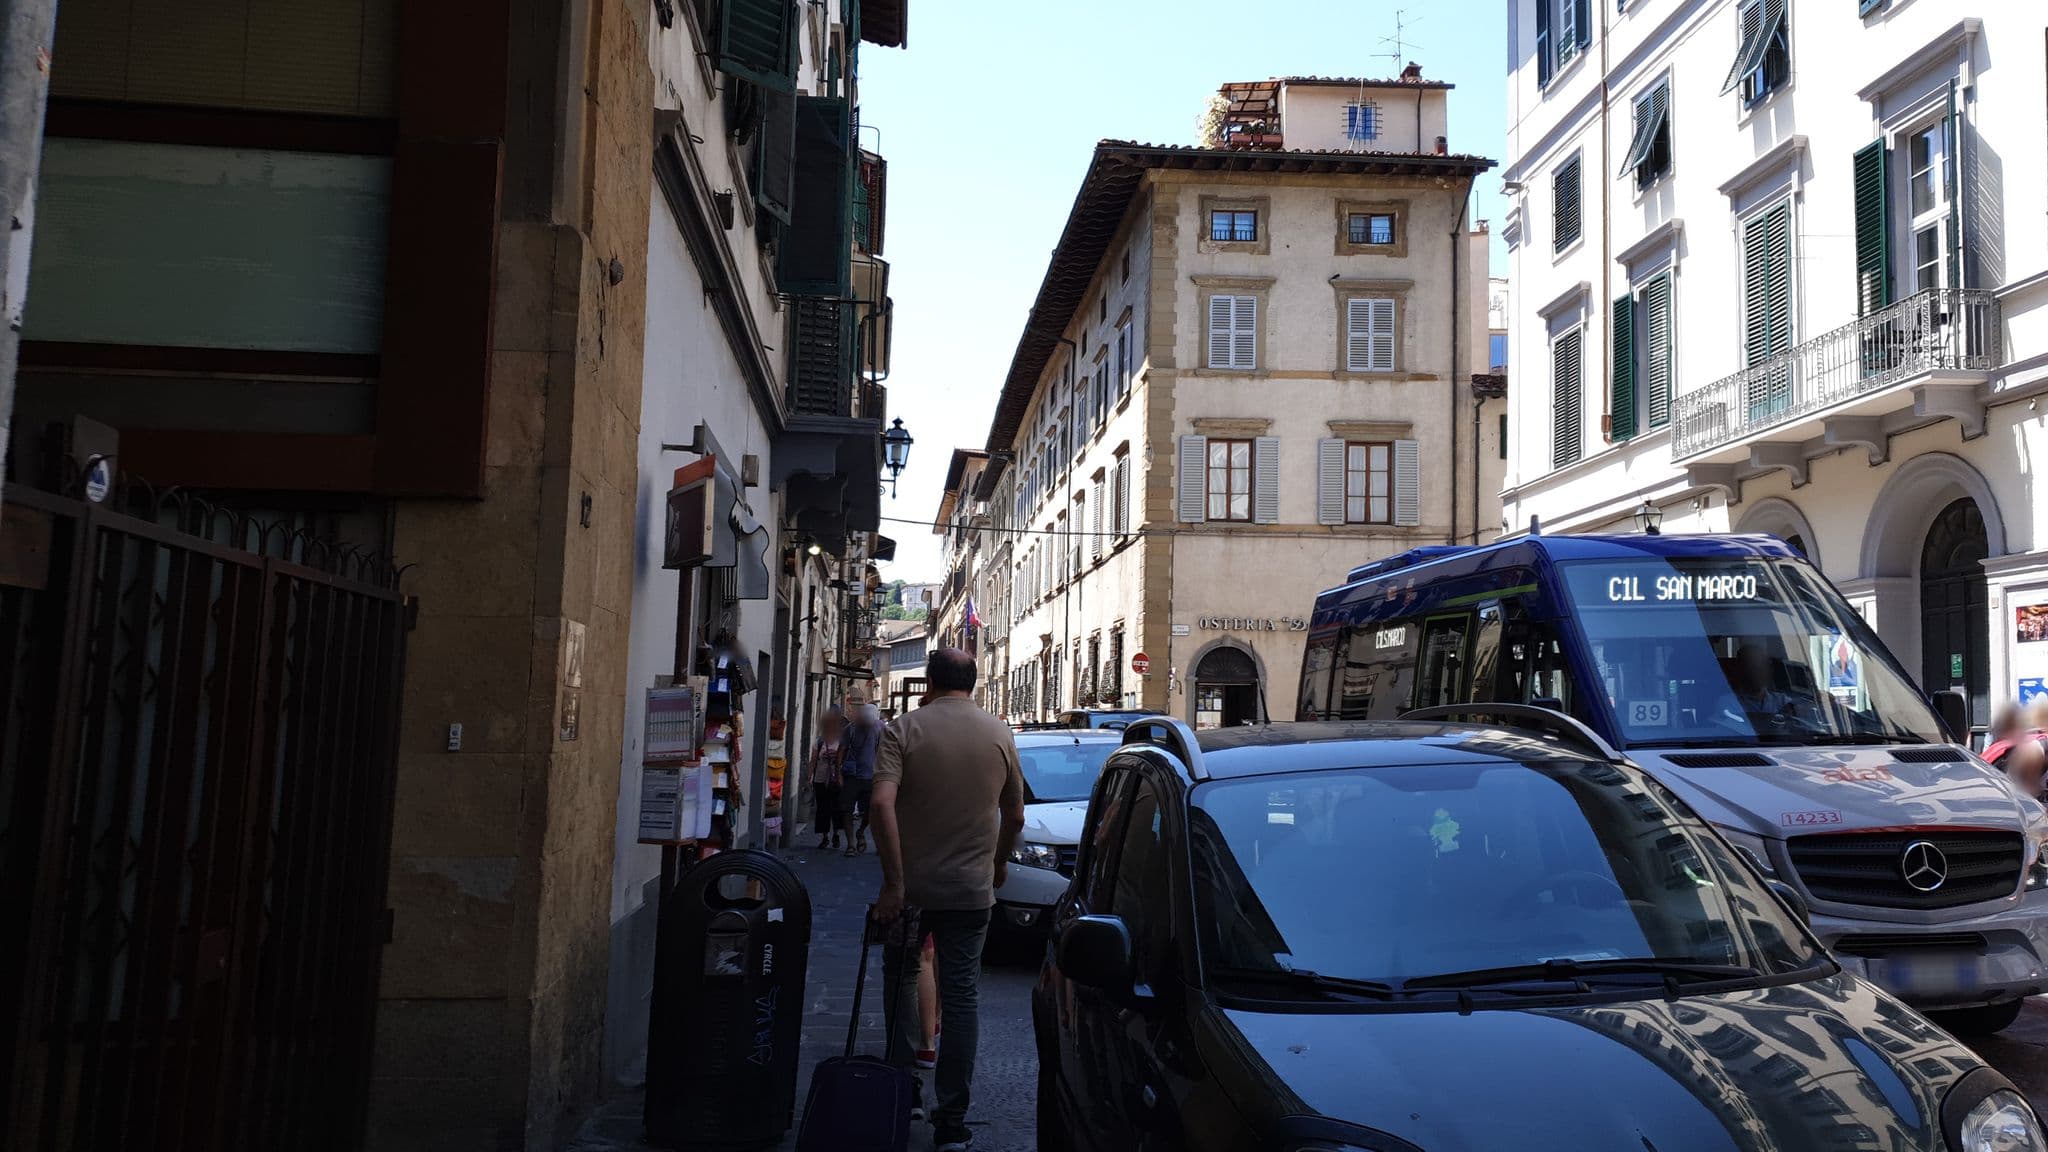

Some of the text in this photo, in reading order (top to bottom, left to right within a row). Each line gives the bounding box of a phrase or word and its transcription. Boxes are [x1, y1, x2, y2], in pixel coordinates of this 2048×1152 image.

[1656, 576, 1692, 601] SAN
[1697, 575, 1757, 600] MARCO
[1199, 616, 1276, 631] OSTERIA
[1635, 704, 1661, 722] 89
[1786, 811, 1839, 825] 14233
